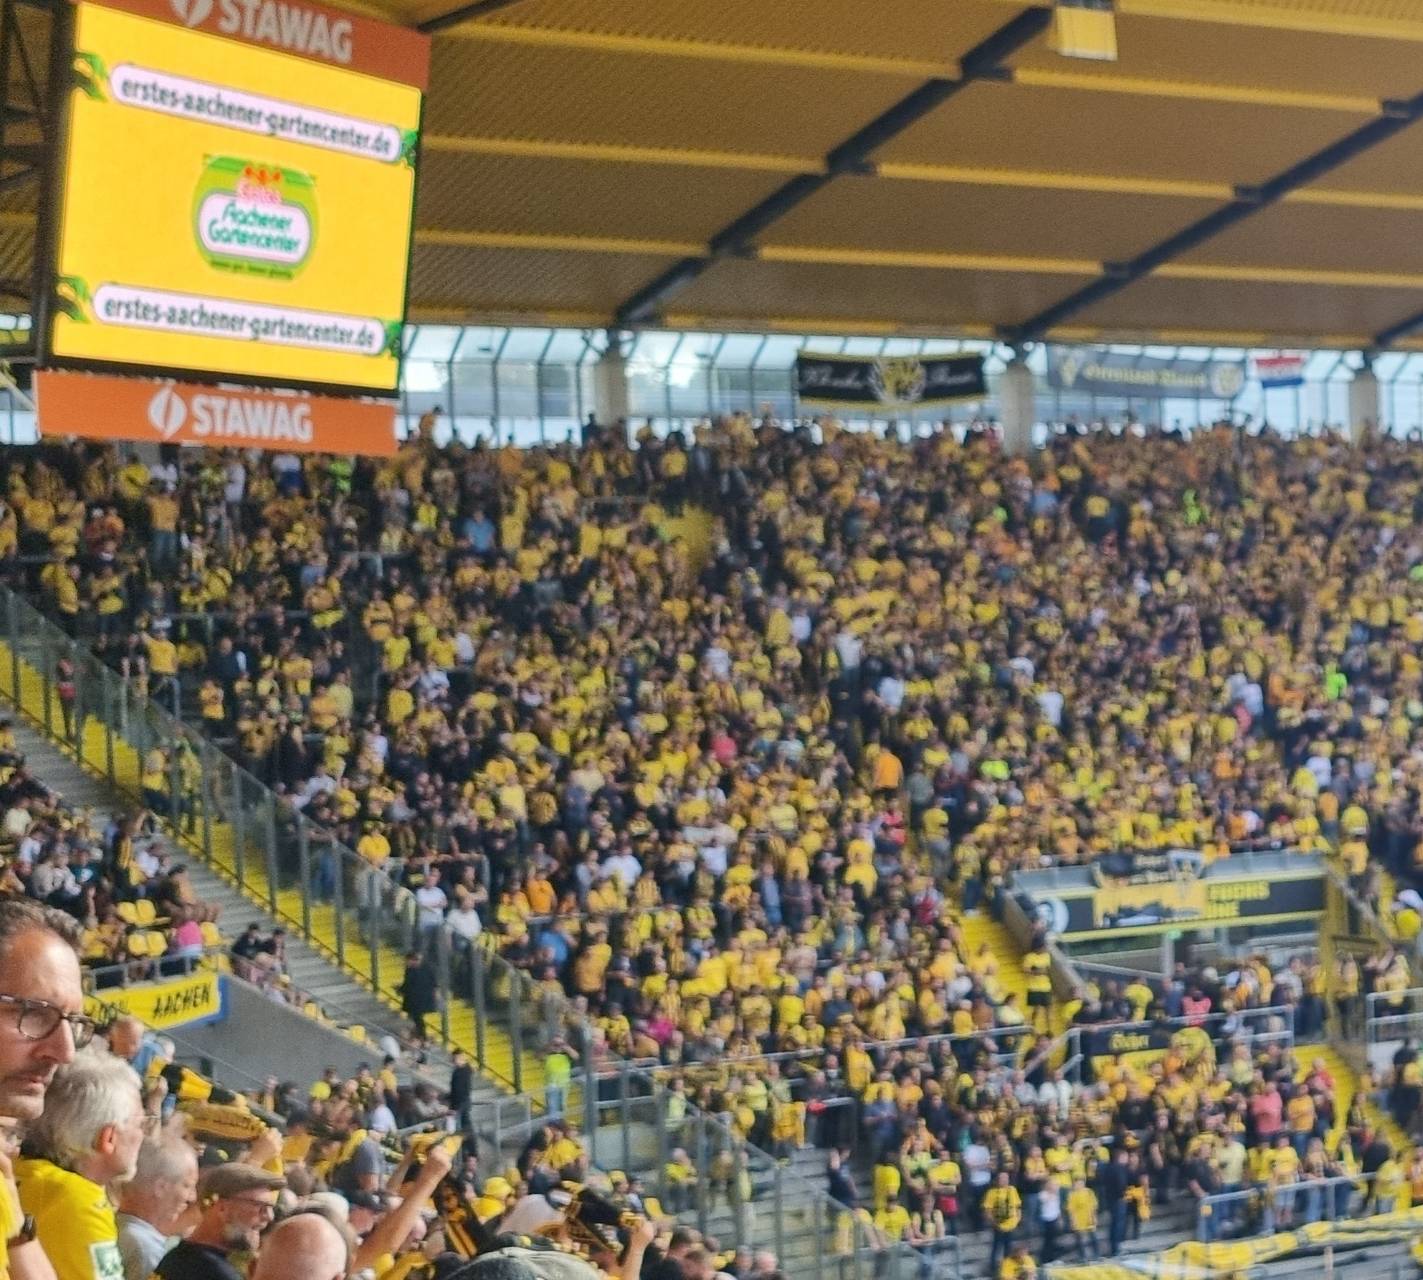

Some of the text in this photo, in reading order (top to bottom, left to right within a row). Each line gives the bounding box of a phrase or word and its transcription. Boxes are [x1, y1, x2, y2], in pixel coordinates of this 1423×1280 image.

[217, 0, 352, 64] STAWAG
[121, 75, 391, 154] erstes-aachener-gartencenter.de
[208, 218, 300, 252] Gartencenter
[221, 200, 291, 230] Aachener
[104, 293, 376, 349] erstes-aachener-gartencenter.de
[192, 397, 313, 442] STAWAG
[152, 981, 212, 1020] AACHEN
